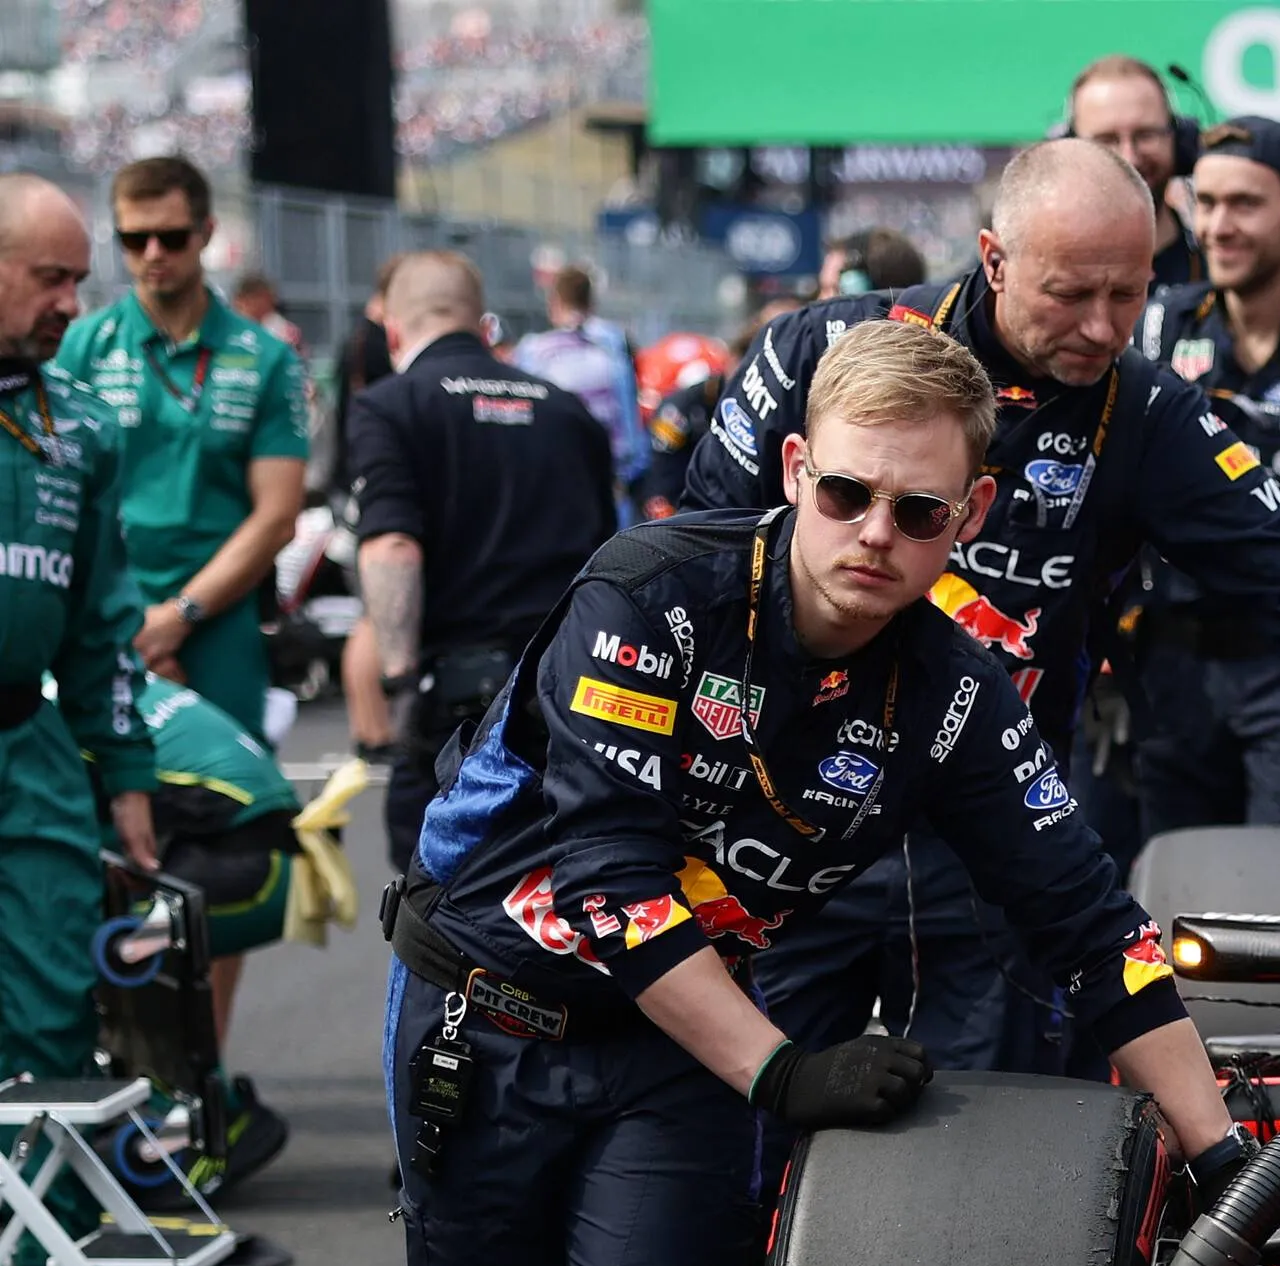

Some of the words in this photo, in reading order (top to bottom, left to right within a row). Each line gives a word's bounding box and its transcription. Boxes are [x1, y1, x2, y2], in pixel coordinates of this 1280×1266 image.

[592, 630, 674, 680] Mobil
[582, 686, 670, 728] PIRELLI
[930, 676, 980, 763] sparco
[680, 753, 729, 786] obil
[471, 983, 503, 1007] PIT
[503, 998, 561, 1031] CREW
